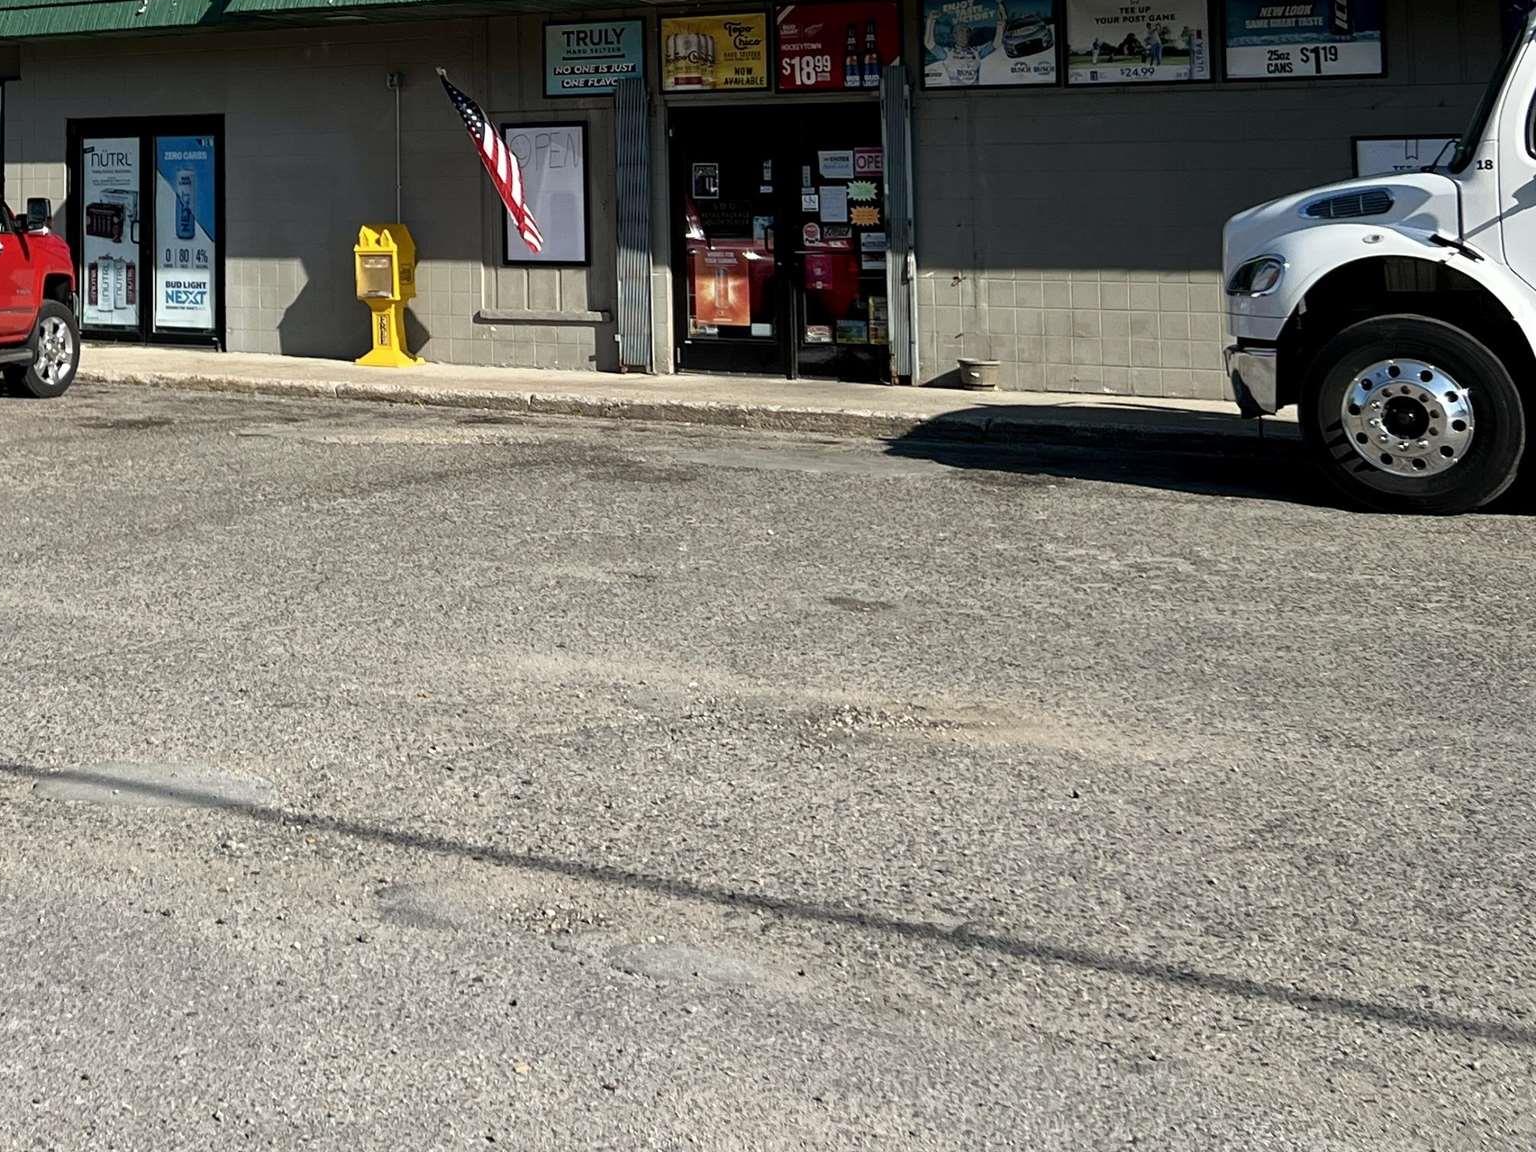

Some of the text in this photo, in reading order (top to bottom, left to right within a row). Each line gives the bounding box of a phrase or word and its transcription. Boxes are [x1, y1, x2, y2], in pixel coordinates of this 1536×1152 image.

[1119, 6, 1151, 15] TEE UP
[1285, 5, 1313, 16] LOOK
[1095, 13, 1176, 25] YOUR POST GAME
[724, 21, 752, 37] Topo
[562, 28, 625, 47] TRULY
[733, 33, 761, 50] Chico
[590, 46, 621, 54] SELTZER
[555, 63, 634, 75] NO ONE IS JUST
[735, 66, 753, 76] NOW
[1267, 62, 1294, 74] CANS
[563, 78, 585, 88] ONE
[724, 76, 764, 86] AVAILABLE
[510, 131, 580, 170] OPEN
[857, 155, 883, 169] OPE
[1476, 160, 1494, 170] 18
[165, 248, 208, 263] 0 80 4%
[165, 280, 207, 289] BUD LIGHT
[165, 290, 208, 305] NEXT
